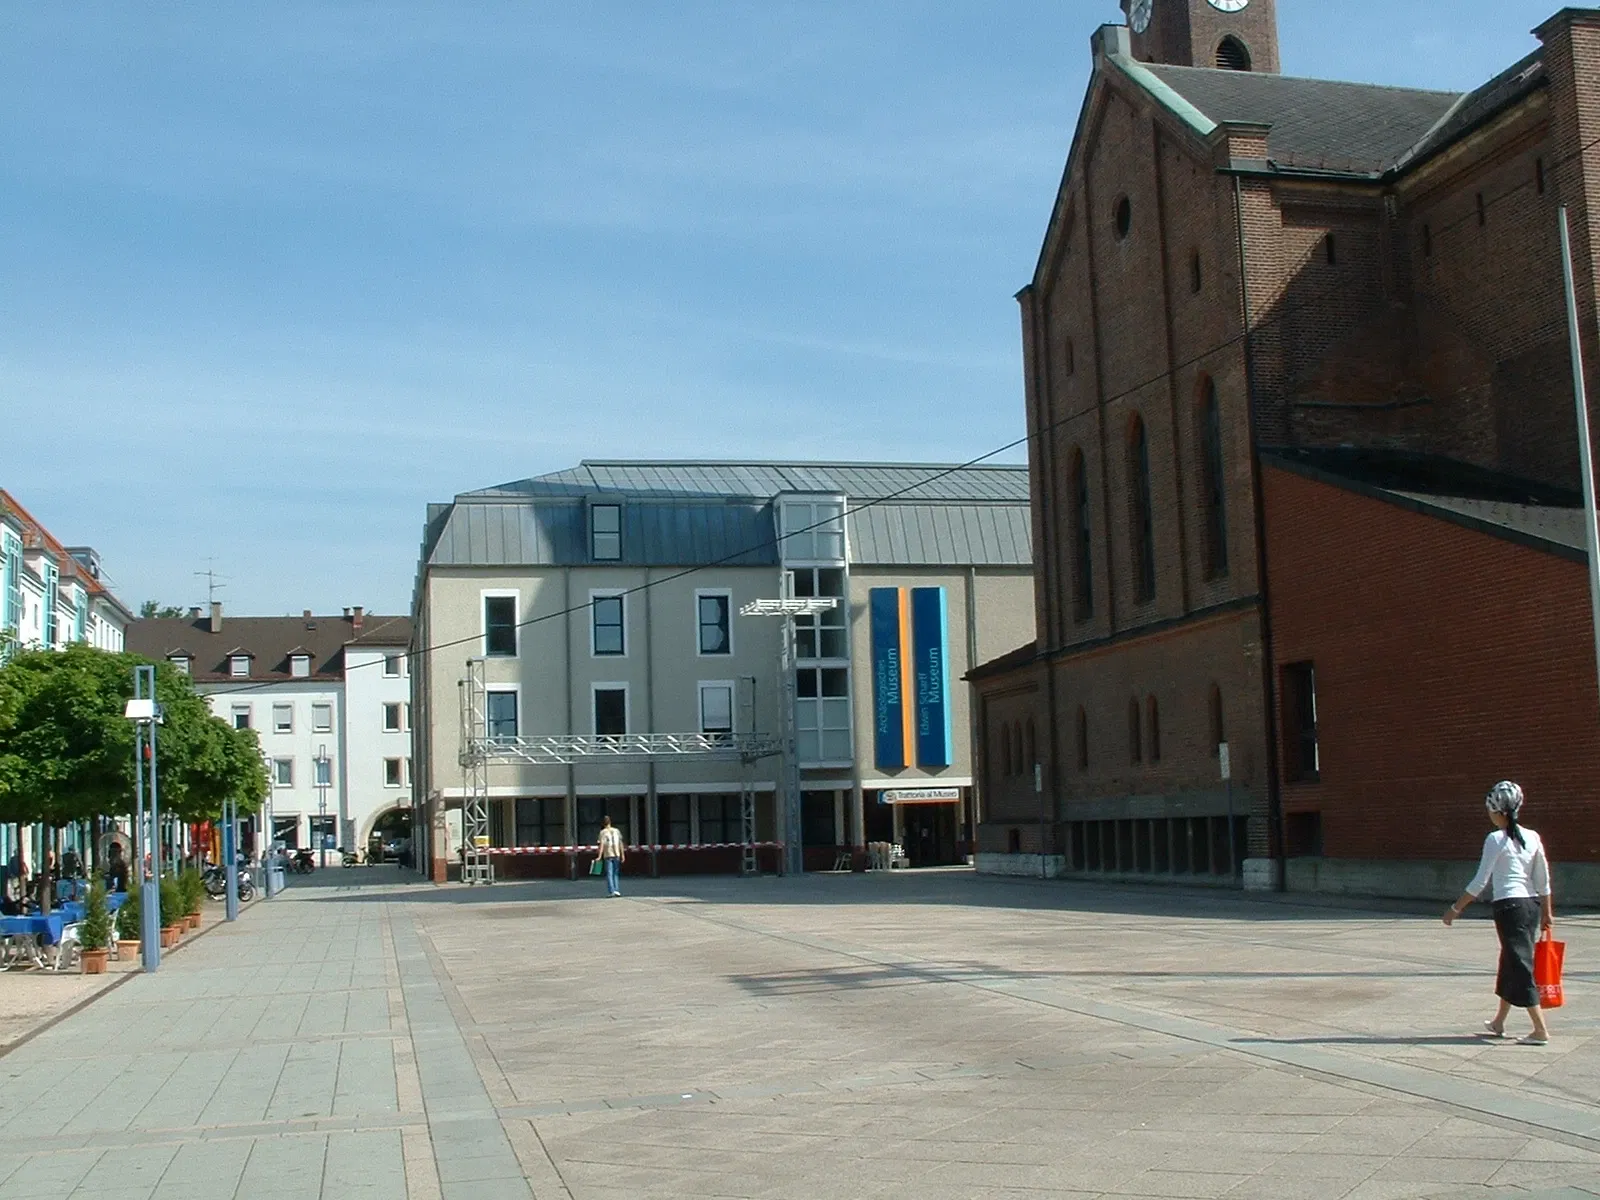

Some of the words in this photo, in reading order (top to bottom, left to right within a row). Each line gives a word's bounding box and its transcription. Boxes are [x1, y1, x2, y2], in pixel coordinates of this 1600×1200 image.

[887, 647, 898, 704] Museum
[918, 672, 929, 705] Scharff
[928, 647, 940, 703] Museum
[919, 707, 930, 736] Edwin
[898, 791, 925, 799] Trattoria
[934, 790, 958, 798] Museo
